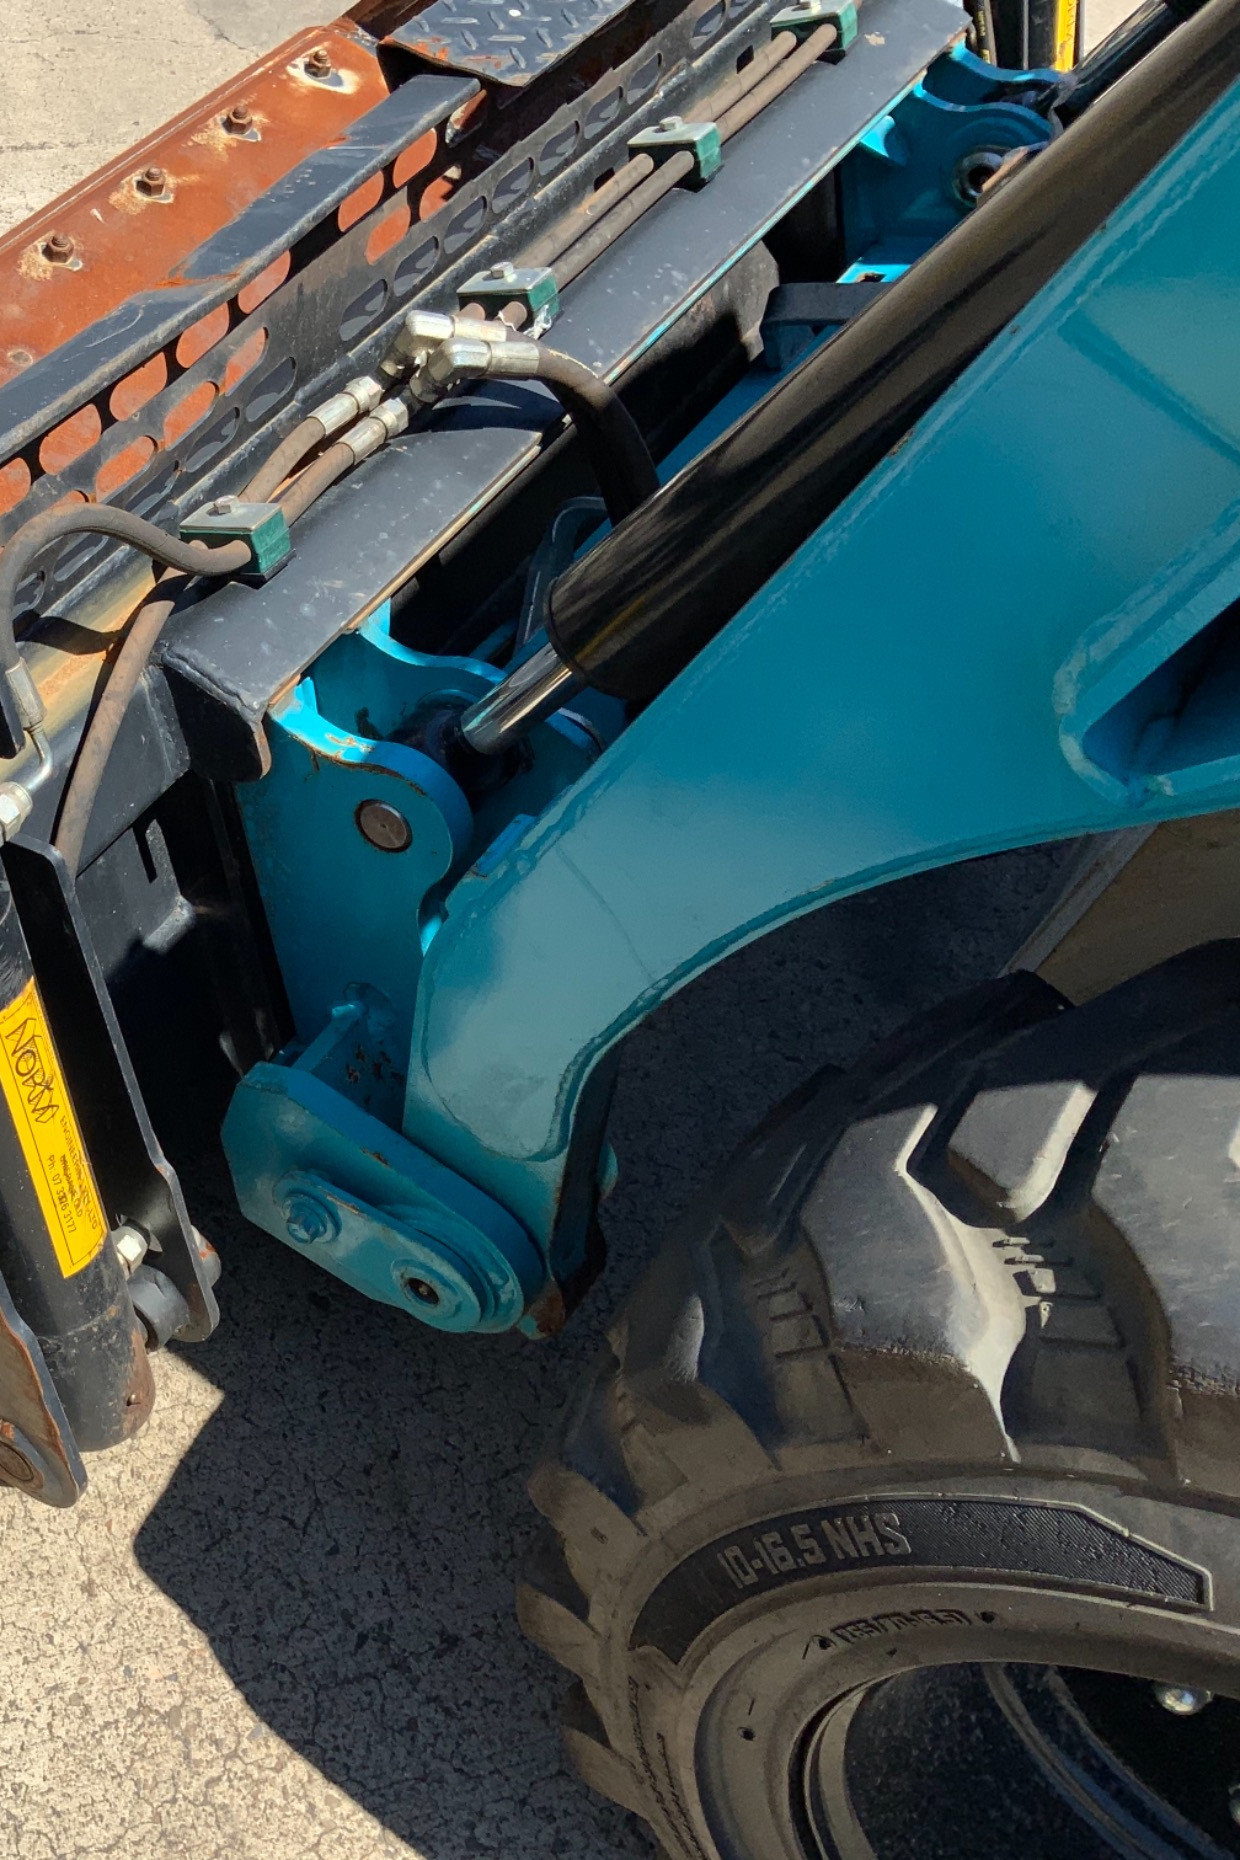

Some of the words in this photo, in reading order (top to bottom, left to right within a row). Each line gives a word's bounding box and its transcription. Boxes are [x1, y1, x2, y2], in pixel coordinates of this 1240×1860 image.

[64, 1212, 77, 1233] 3177
[717, 1523, 826, 1589] 10-16.5
[821, 1513, 912, 1559] NHS
